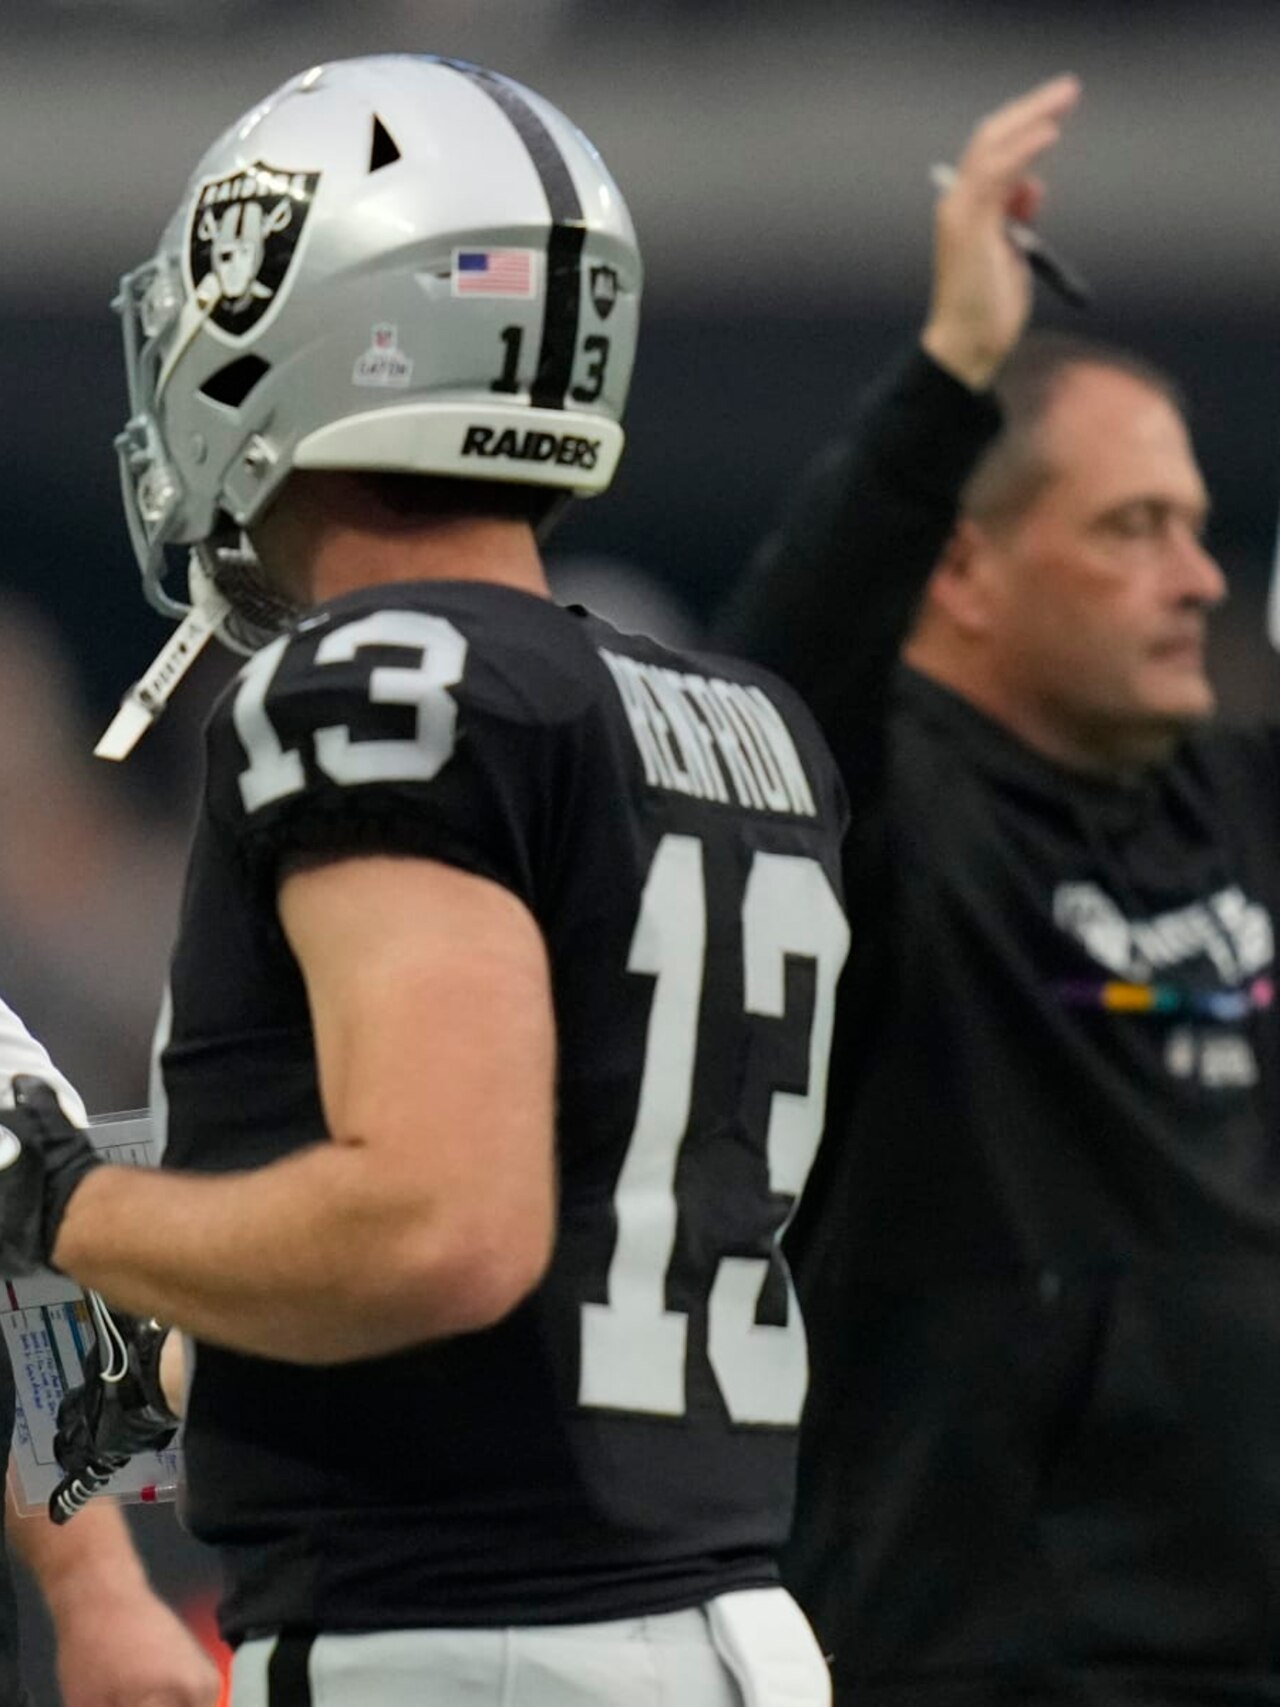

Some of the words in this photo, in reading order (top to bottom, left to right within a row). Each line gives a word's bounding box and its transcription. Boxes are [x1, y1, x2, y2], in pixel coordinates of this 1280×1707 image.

[461, 426, 602, 470] RAIDERS
[233, 610, 467, 814] 13
[578, 833, 852, 1425] 13
